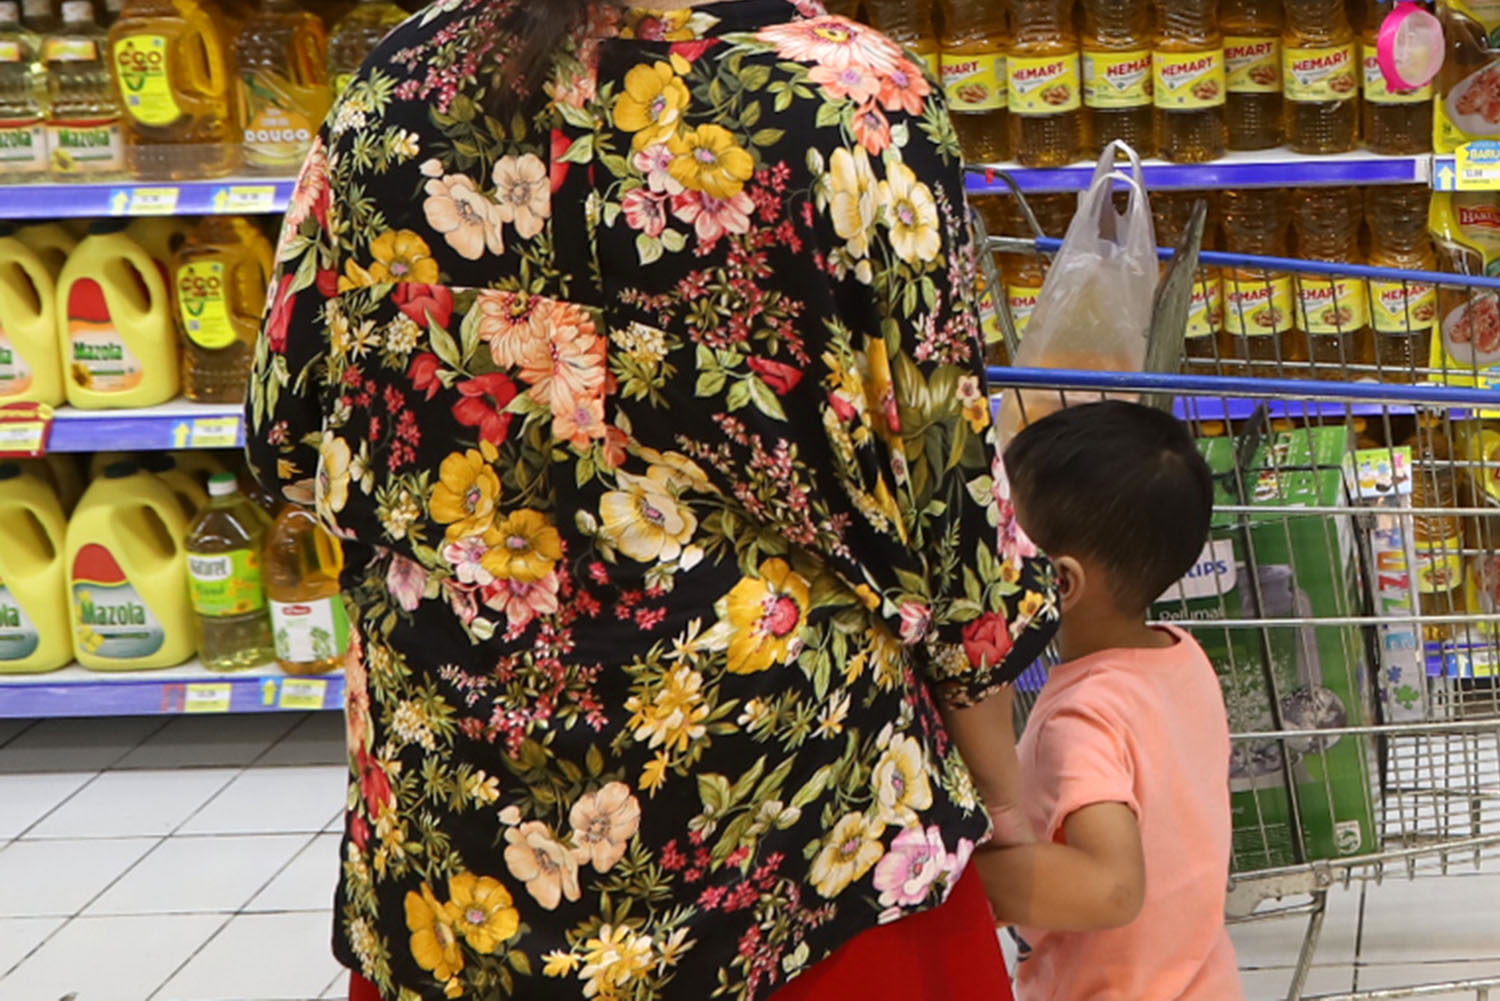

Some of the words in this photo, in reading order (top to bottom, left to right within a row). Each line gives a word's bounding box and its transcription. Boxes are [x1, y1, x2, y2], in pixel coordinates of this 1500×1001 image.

[1160, 56, 1214, 78] HEMART
[1291, 49, 1350, 73] HEMART
[81, 601, 146, 625] Mazola
